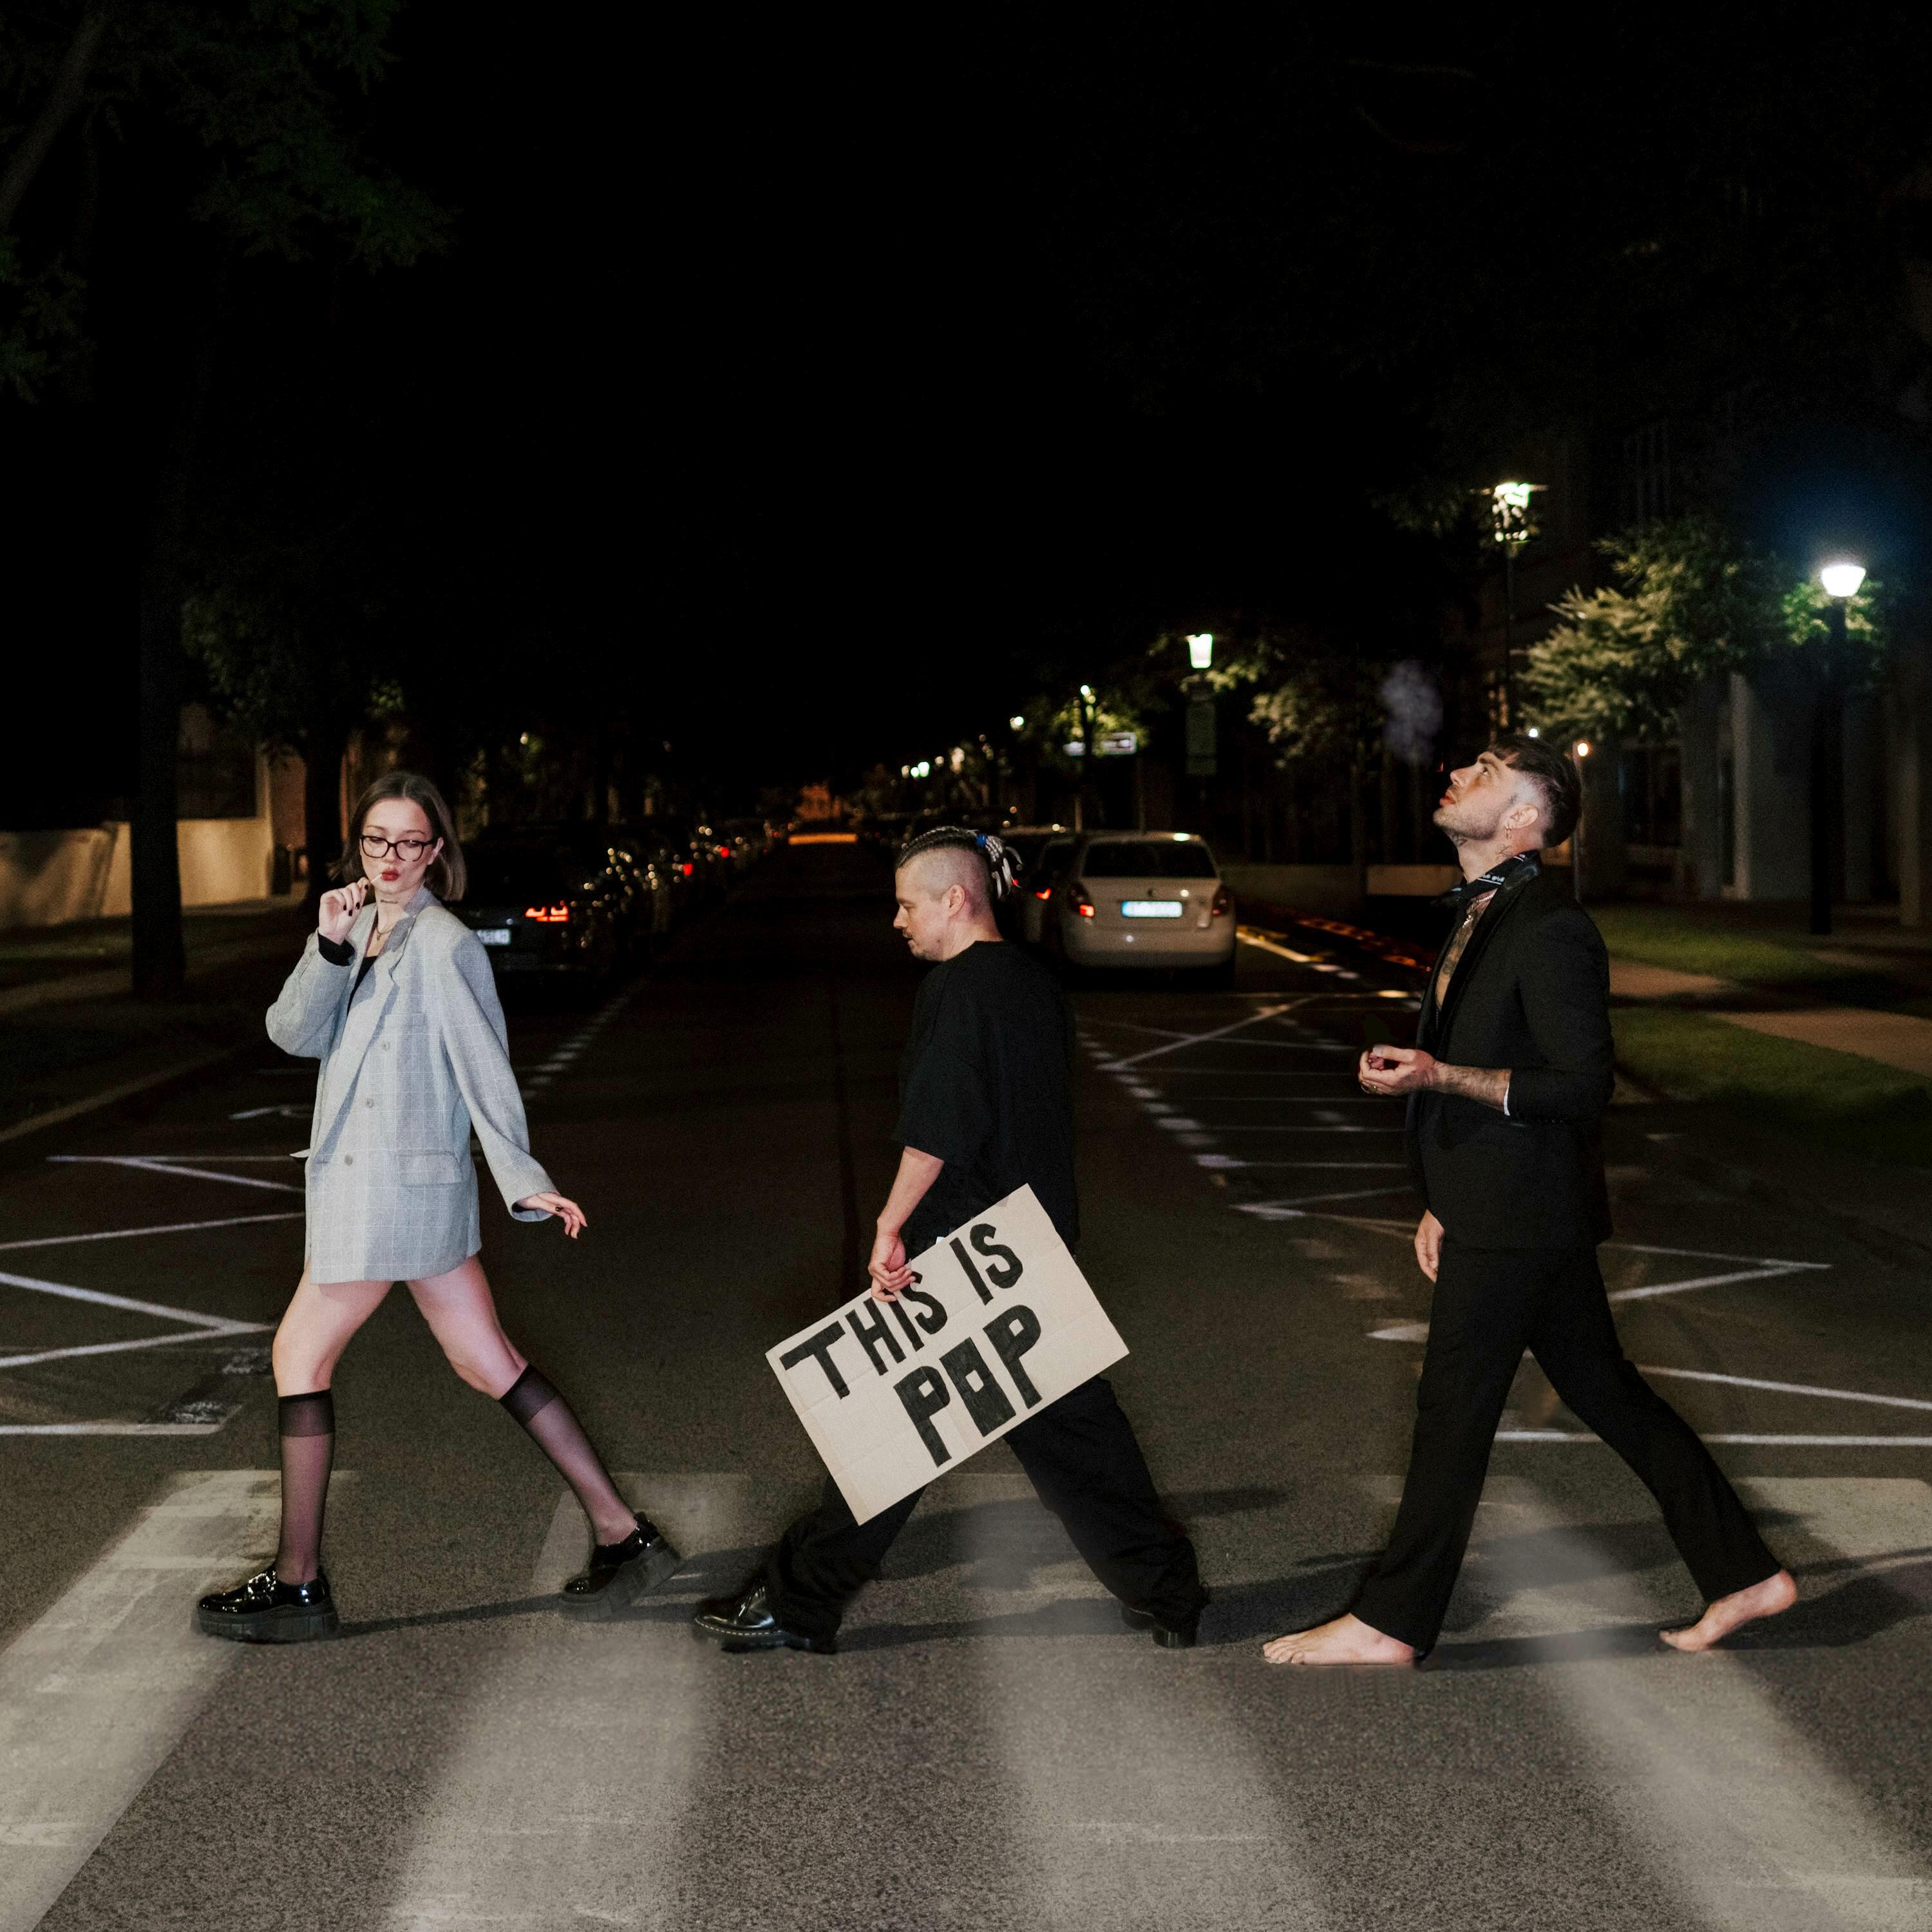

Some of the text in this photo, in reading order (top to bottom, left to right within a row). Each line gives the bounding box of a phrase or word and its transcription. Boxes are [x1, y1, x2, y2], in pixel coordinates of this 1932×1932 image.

[779, 1223, 1023, 1400] THIS IS
[893, 1305, 1043, 1468] POP
